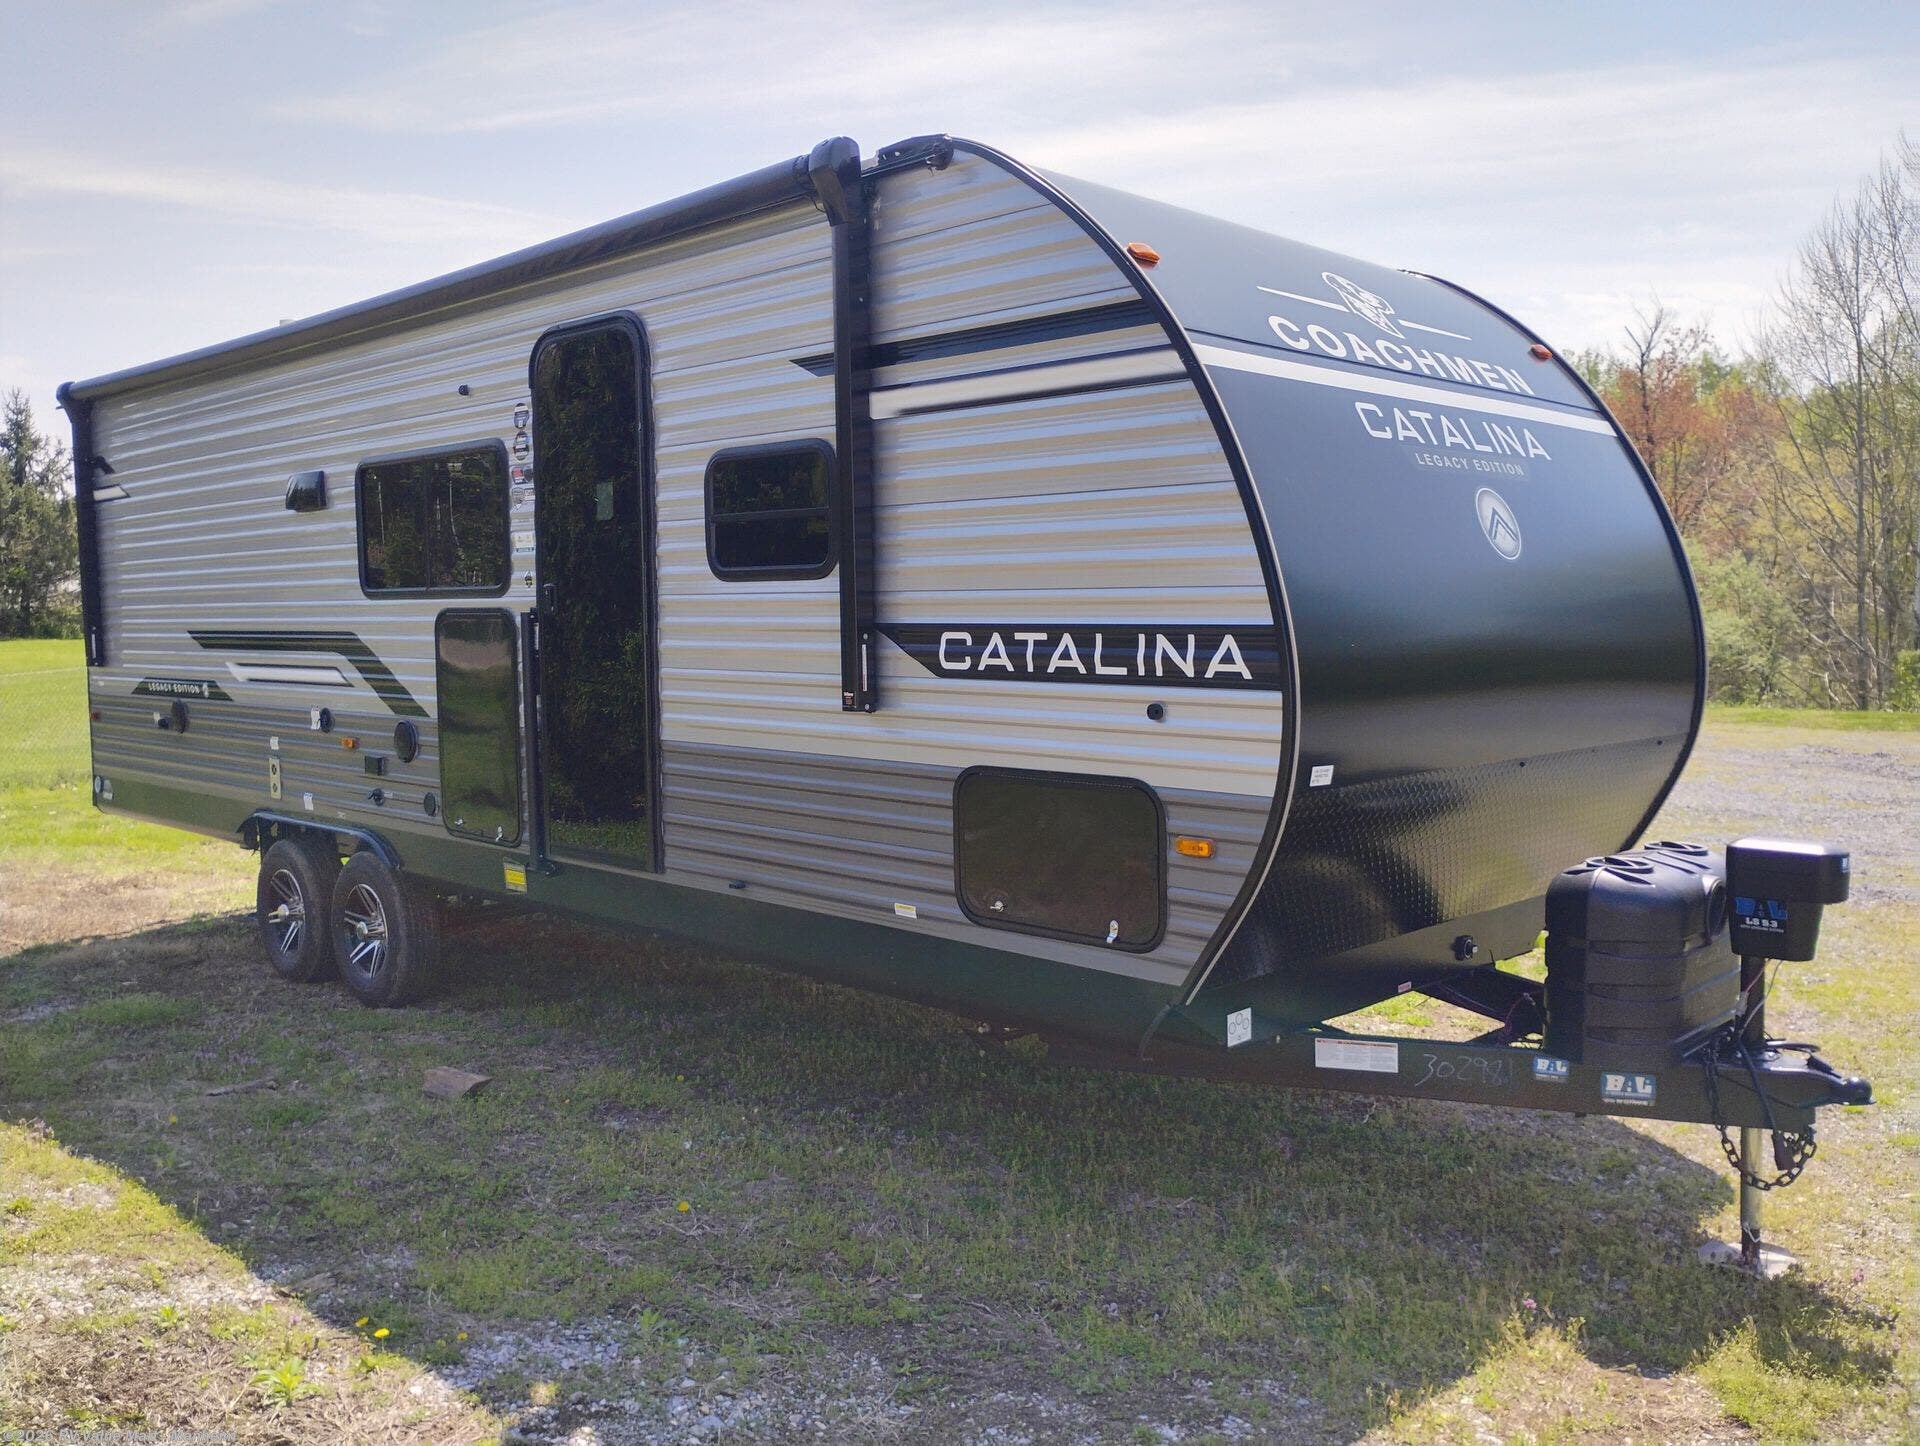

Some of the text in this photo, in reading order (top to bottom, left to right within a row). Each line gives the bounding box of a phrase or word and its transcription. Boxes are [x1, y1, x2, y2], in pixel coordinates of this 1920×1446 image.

[1268, 316, 1535, 395] COACHMEN
[1355, 402, 1552, 460] CATALINA
[1415, 453, 1524, 476] LEGACY EDITION
[938, 631, 1253, 681] CATALINA
[149, 683, 200, 694] LEGACY EDITION
